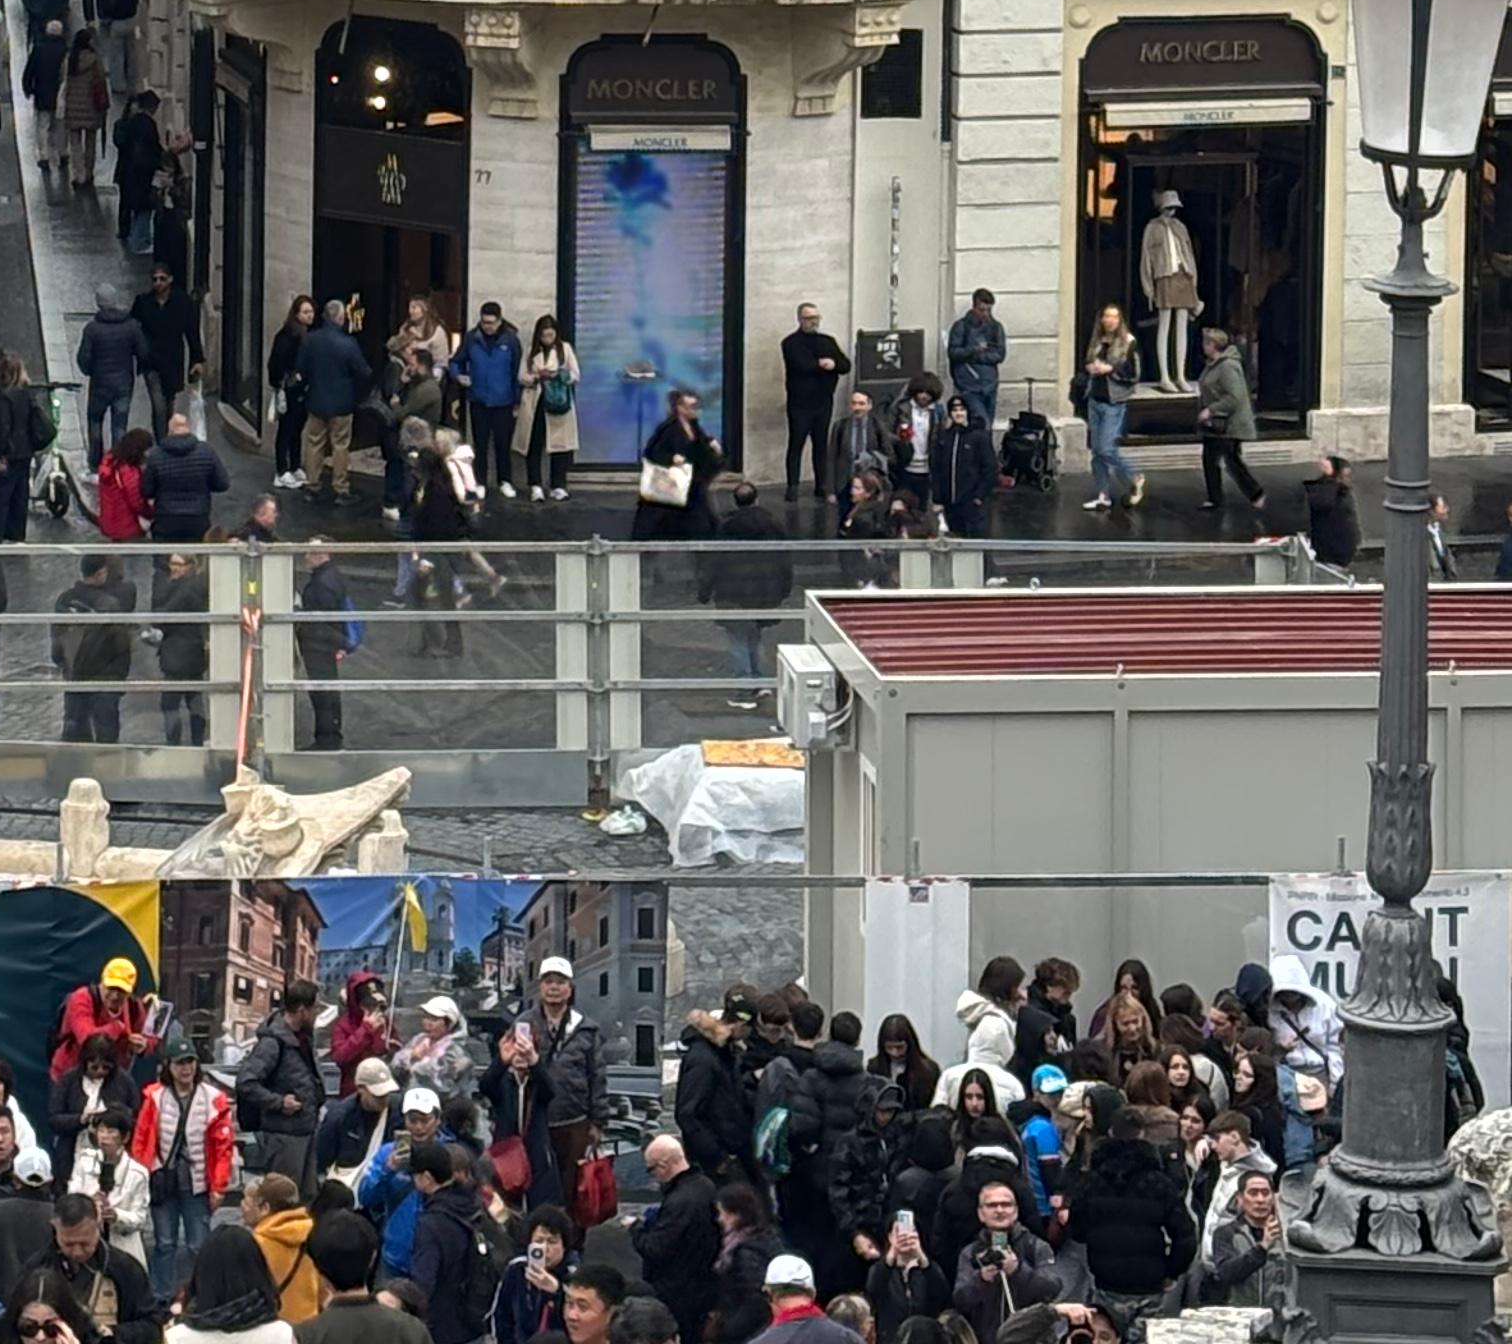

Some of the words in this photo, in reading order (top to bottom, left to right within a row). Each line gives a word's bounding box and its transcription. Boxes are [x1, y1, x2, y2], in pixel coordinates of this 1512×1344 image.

[1140, 40, 1263, 63] MONCLER
[586, 78, 718, 100] MONCLER
[632, 137, 688, 148] MONCLER
[1287, 906, 1469, 952] CAT
